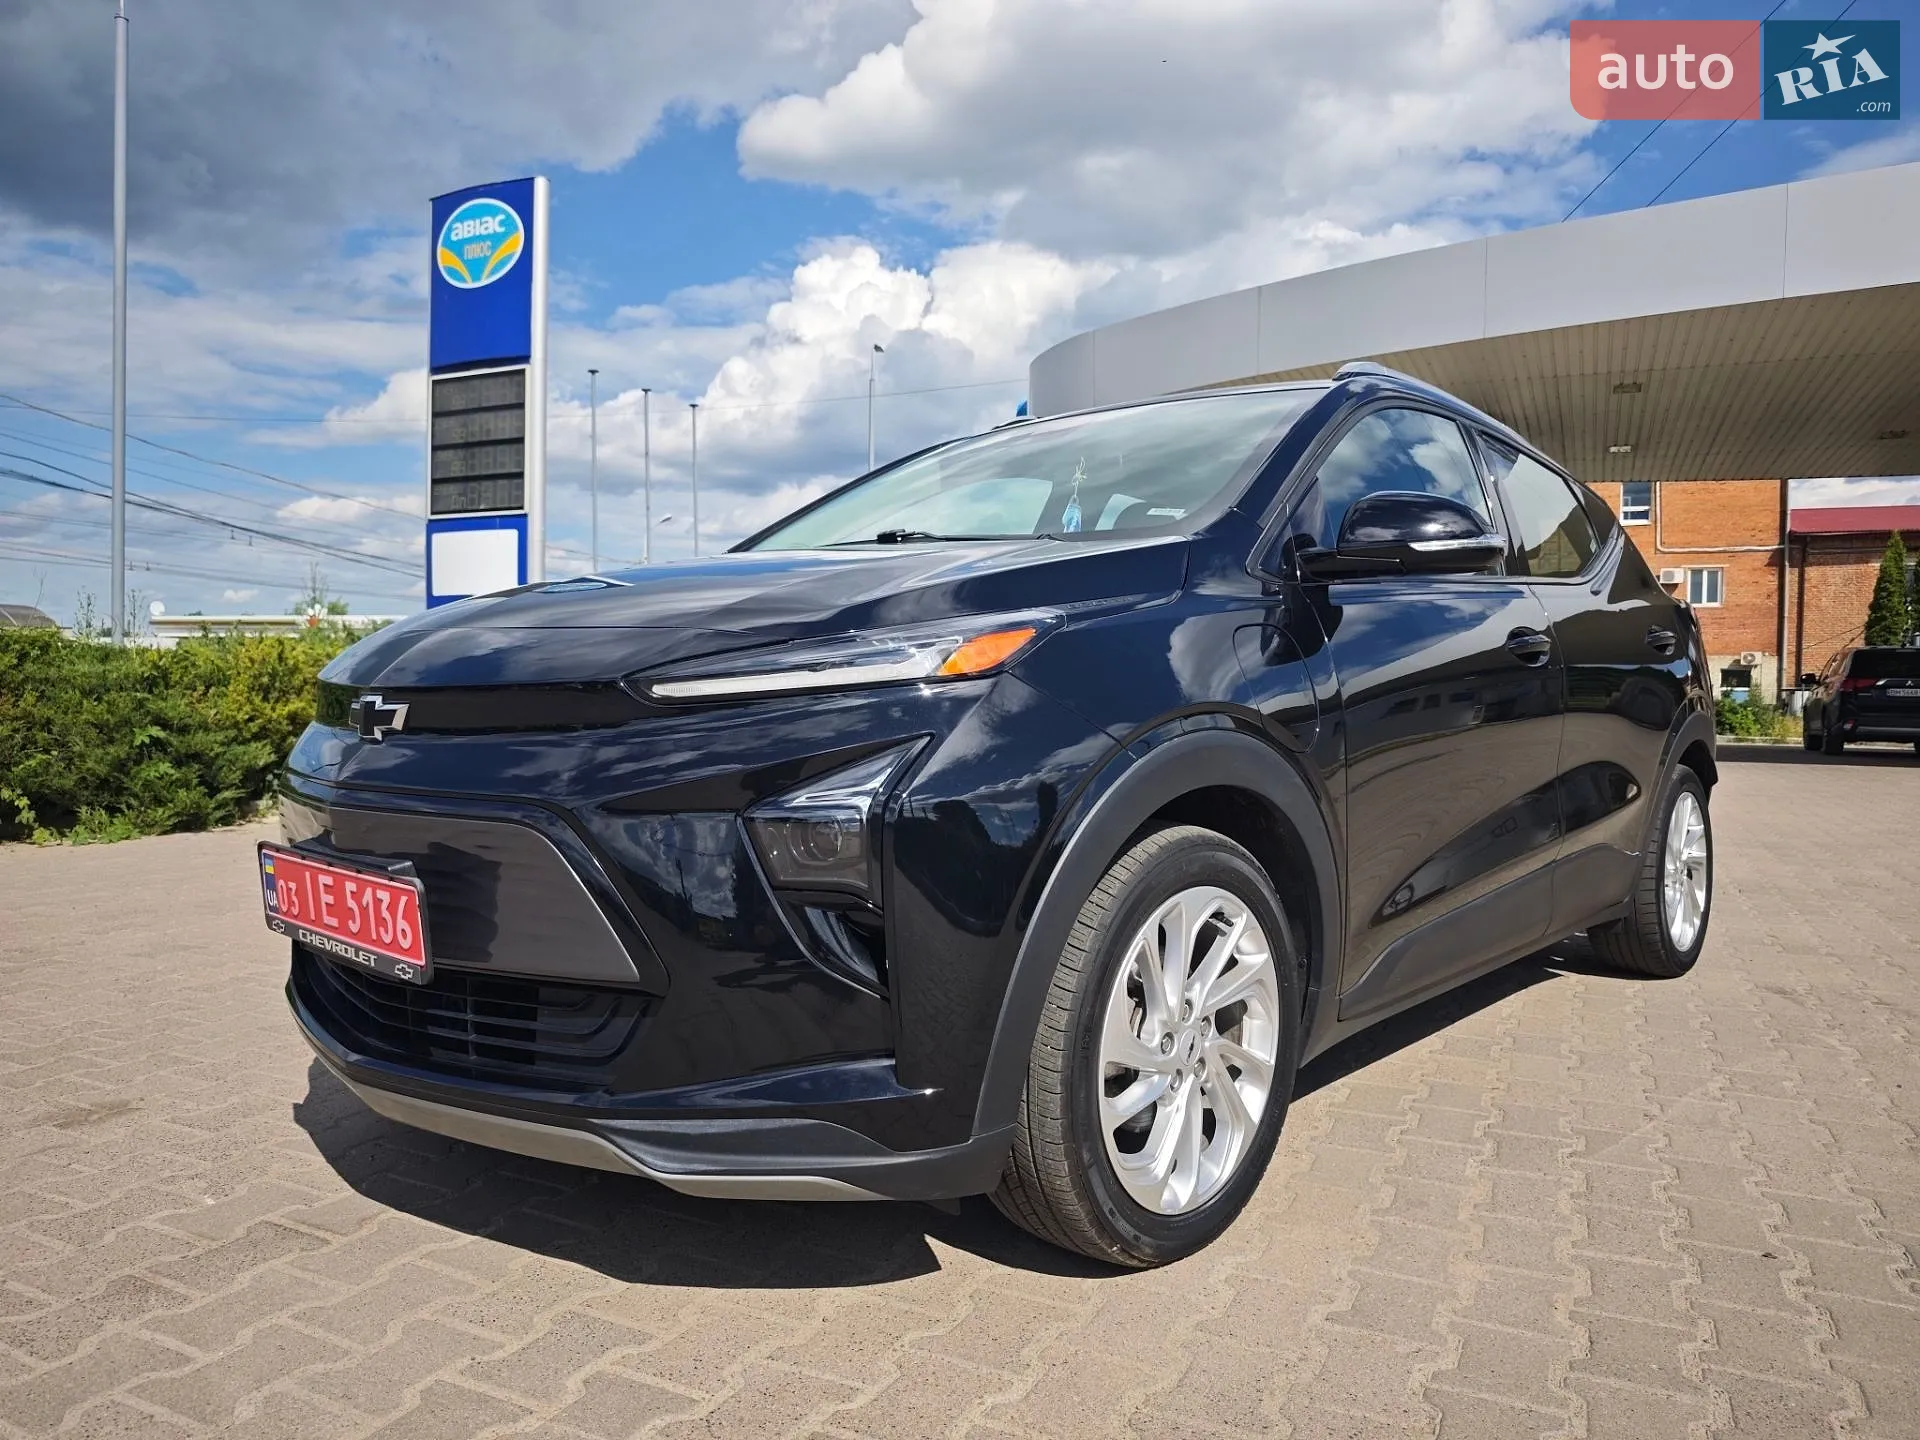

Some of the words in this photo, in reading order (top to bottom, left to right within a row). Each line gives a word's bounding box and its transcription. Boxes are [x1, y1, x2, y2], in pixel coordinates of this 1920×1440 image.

[266, 889, 278, 907] UA
[277, 879, 300, 917] 03
[305, 872, 339, 929] IE
[344, 881, 413, 950] 5136
[298, 929, 378, 967] CHEVROLET
